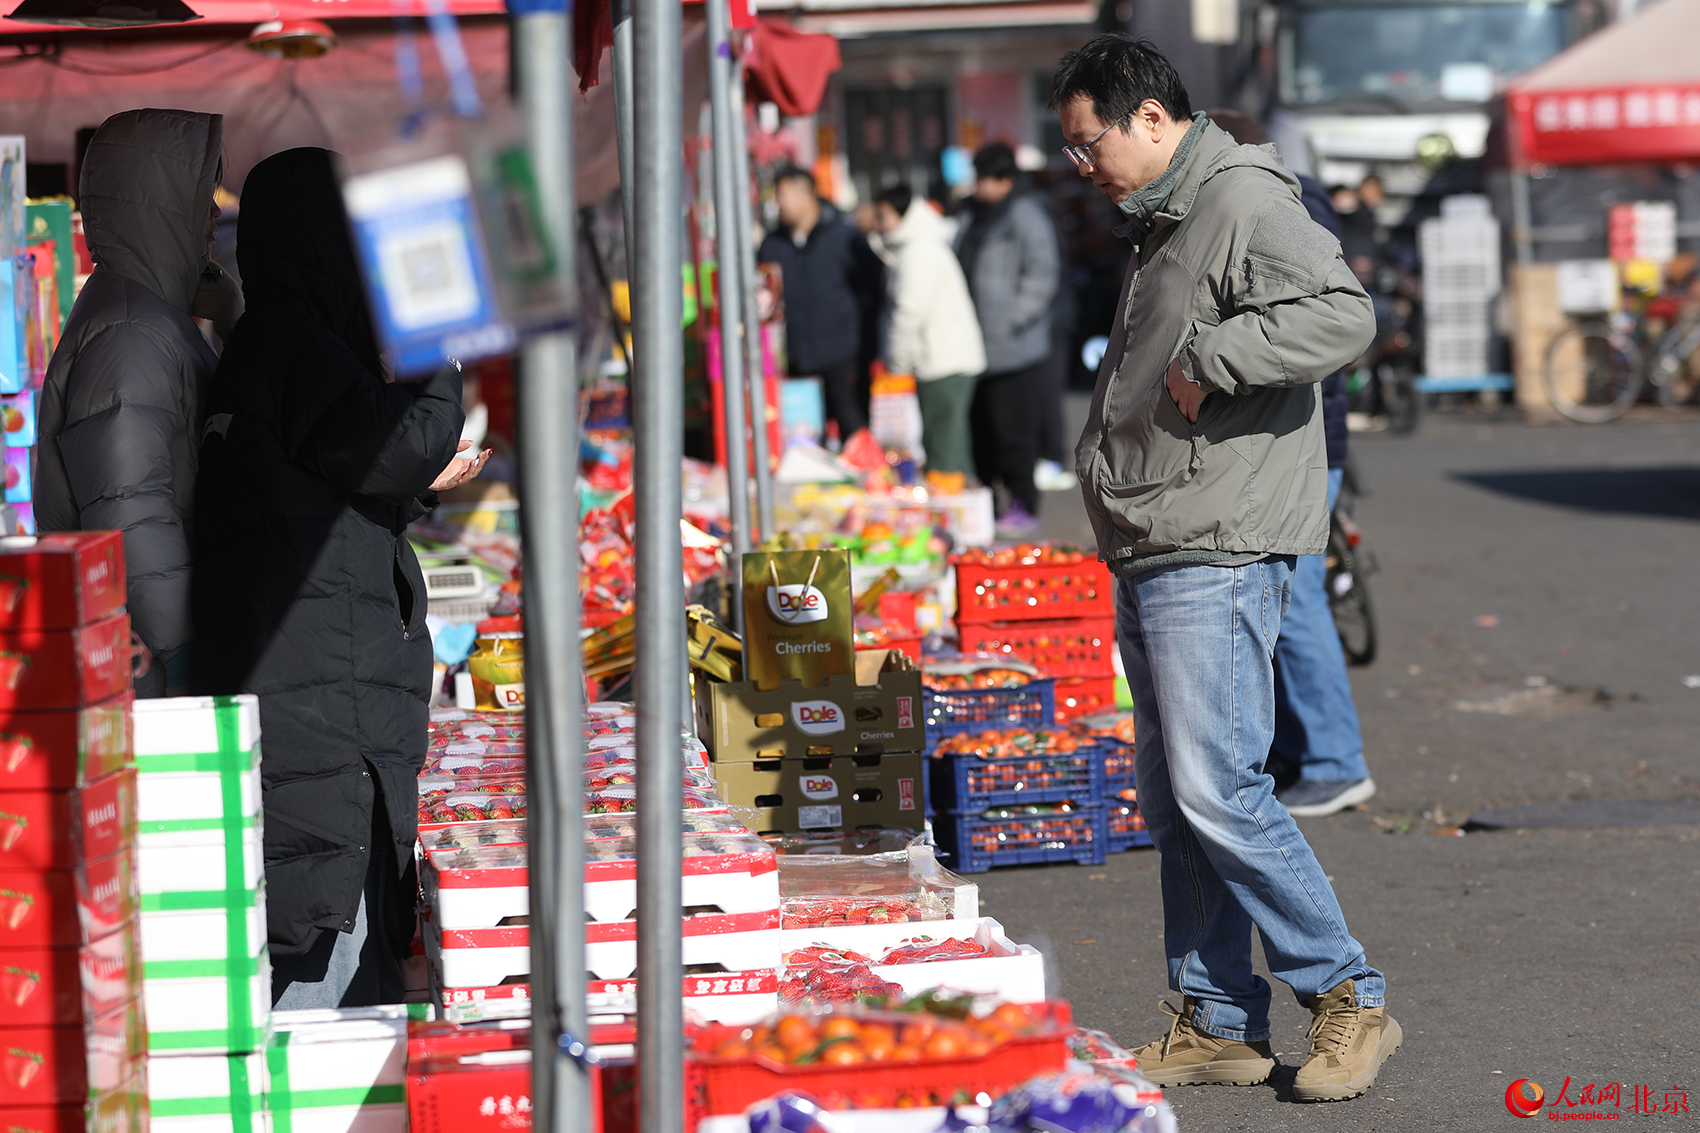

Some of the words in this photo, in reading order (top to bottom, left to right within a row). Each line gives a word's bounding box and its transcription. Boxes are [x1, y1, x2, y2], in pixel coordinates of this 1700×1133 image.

[767, 633, 804, 642] Premium
[775, 641, 831, 655] Cherries
[506, 690, 525, 703] Do
[800, 706, 837, 722] Dole
[860, 731, 895, 741] Cherries
[805, 779, 833, 791] Dole
